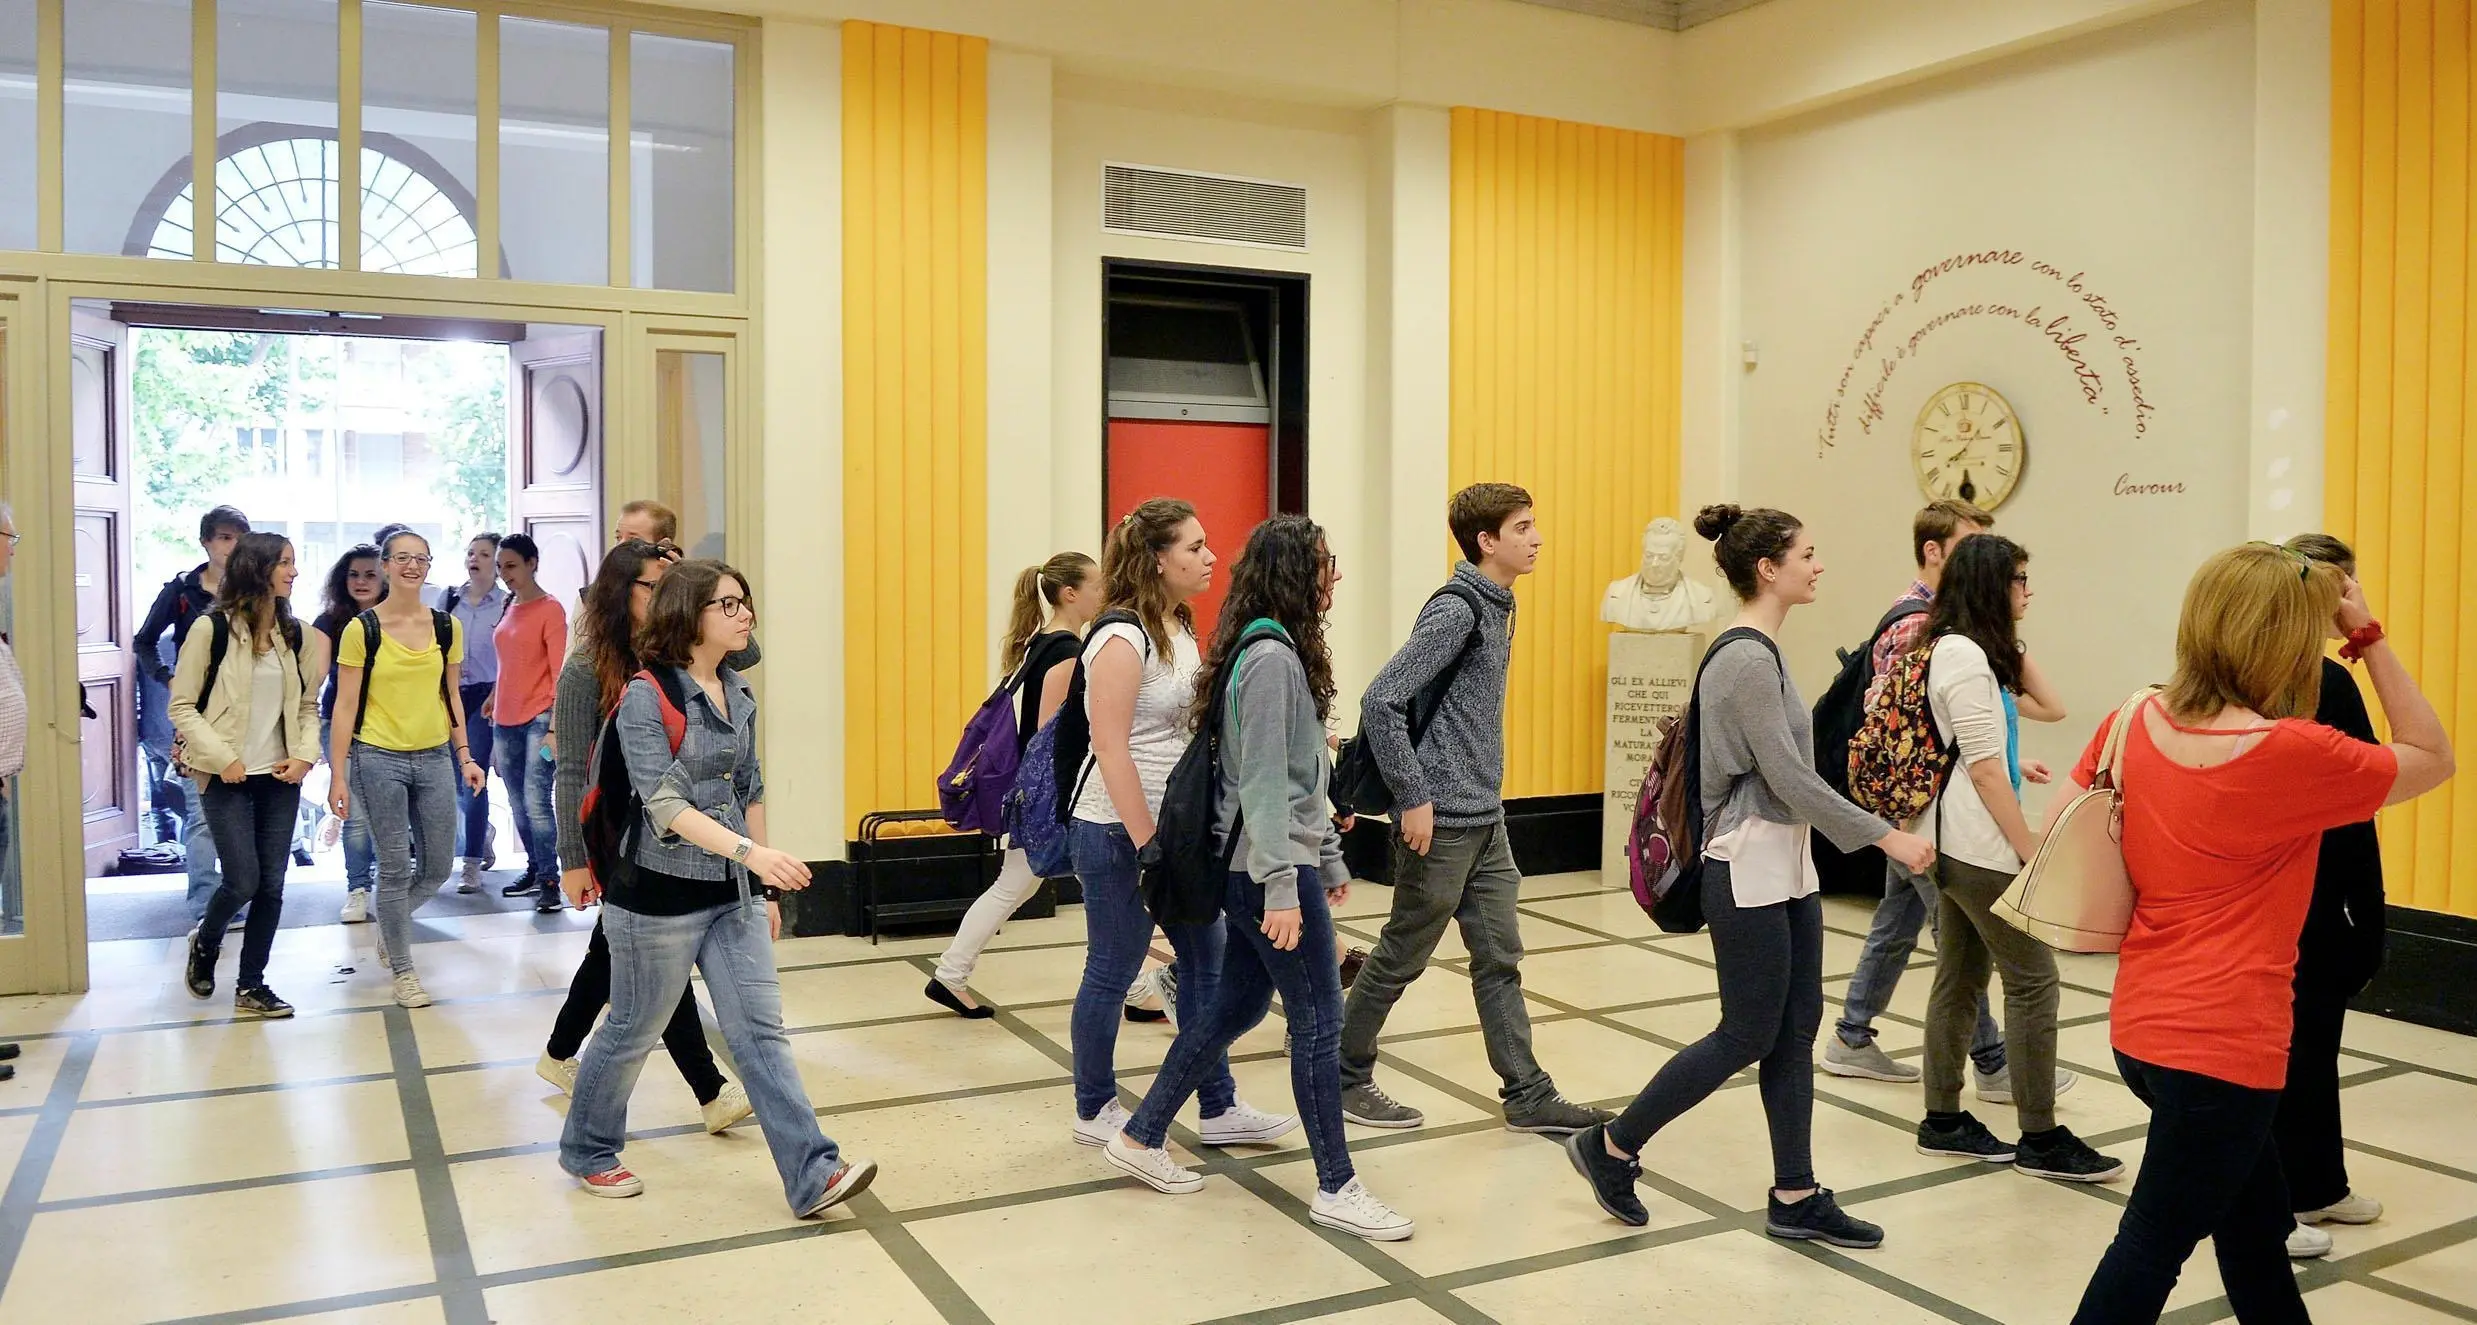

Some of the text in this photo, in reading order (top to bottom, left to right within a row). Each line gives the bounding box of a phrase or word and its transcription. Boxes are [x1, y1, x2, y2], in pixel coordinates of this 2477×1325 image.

[1911, 249, 2024, 303] governare
[2030, 260, 2062, 281] con
[2066, 271, 2085, 293] lo
[2082, 292, 2119, 331] stato
[1858, 358, 1896, 435] difficile
[1907, 304, 1984, 357] governare
[1988, 304, 2021, 319] con
[2024, 306, 2042, 328] la
[2113, 472, 2187, 496] Cavour
[1610, 677, 1687, 688] GLI EX ALLIEVI
[1627, 690, 1669, 700] CHE QUI
[1612, 714, 1660, 724] FERMENT
[1640, 728, 1653, 737] LA
[1613, 740, 1659, 750] MATURA
